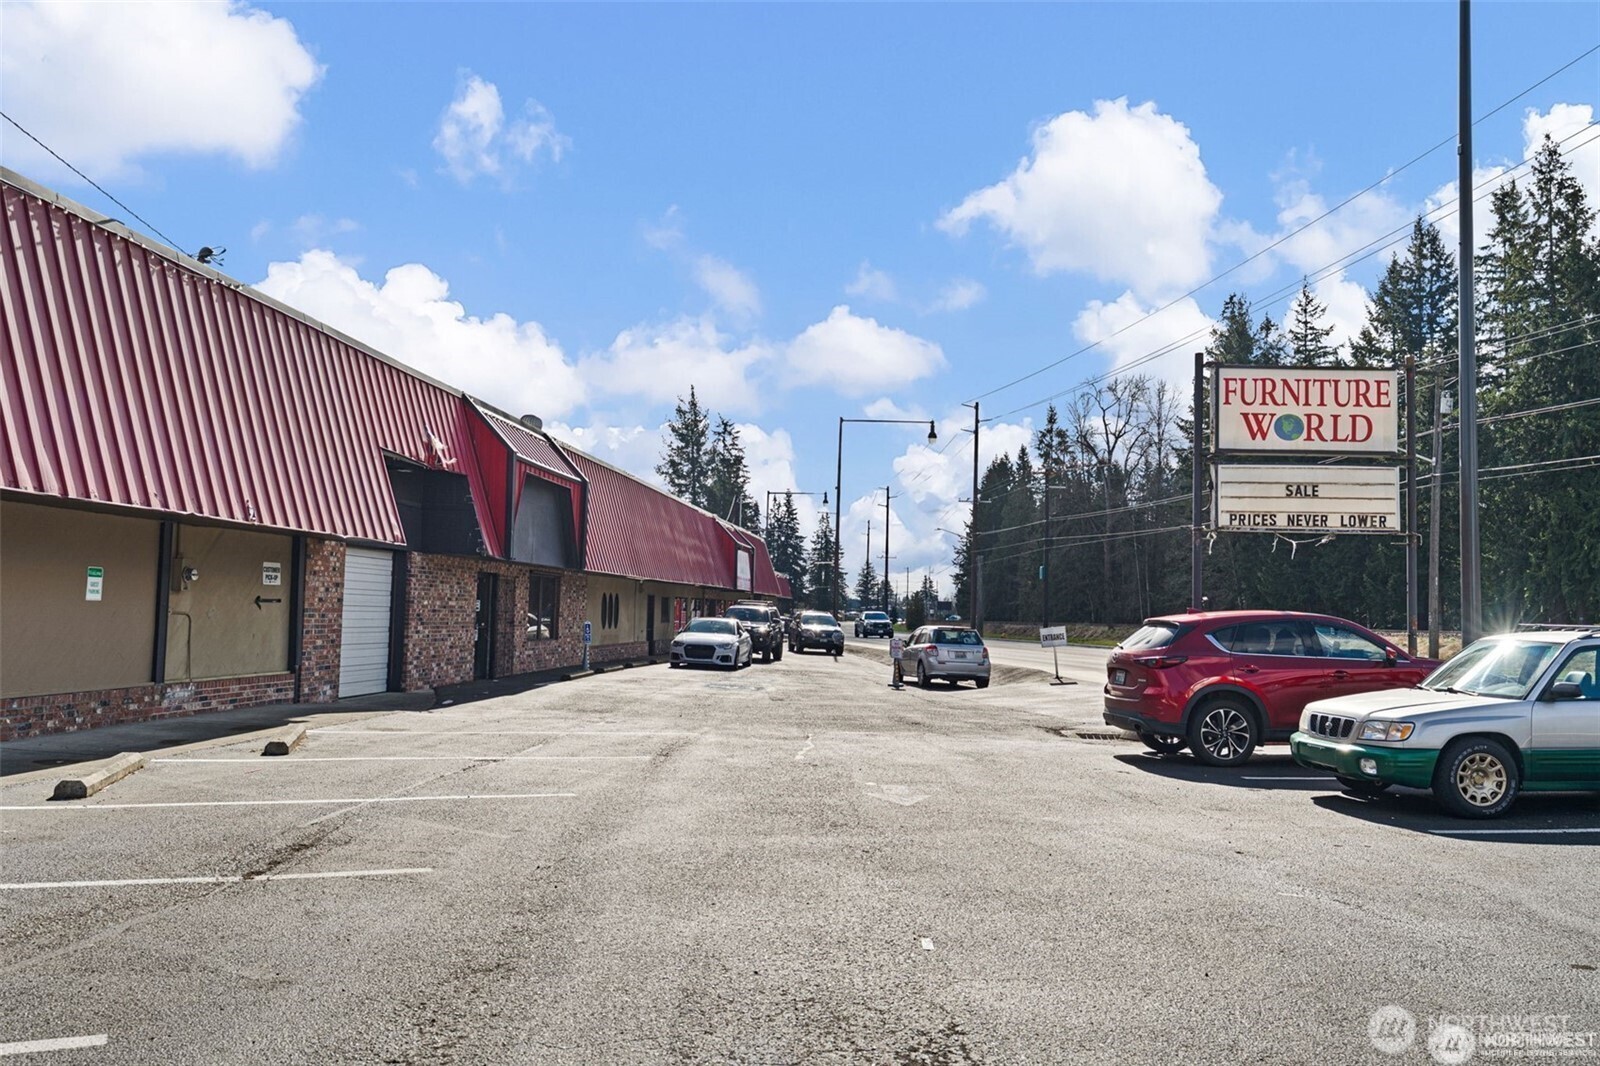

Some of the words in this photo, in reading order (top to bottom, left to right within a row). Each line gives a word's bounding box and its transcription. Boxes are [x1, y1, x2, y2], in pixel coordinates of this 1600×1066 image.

[1223, 377, 1391, 408] FURNITURE
[1240, 412, 1373, 443] WORLD
[1285, 485, 1319, 497] SALE
[1229, 513, 1277, 527] PRICES
[1287, 514, 1328, 527] NEVER
[1340, 515, 1387, 528] LOWER
[1042, 632, 1065, 642] ENTRANCE
